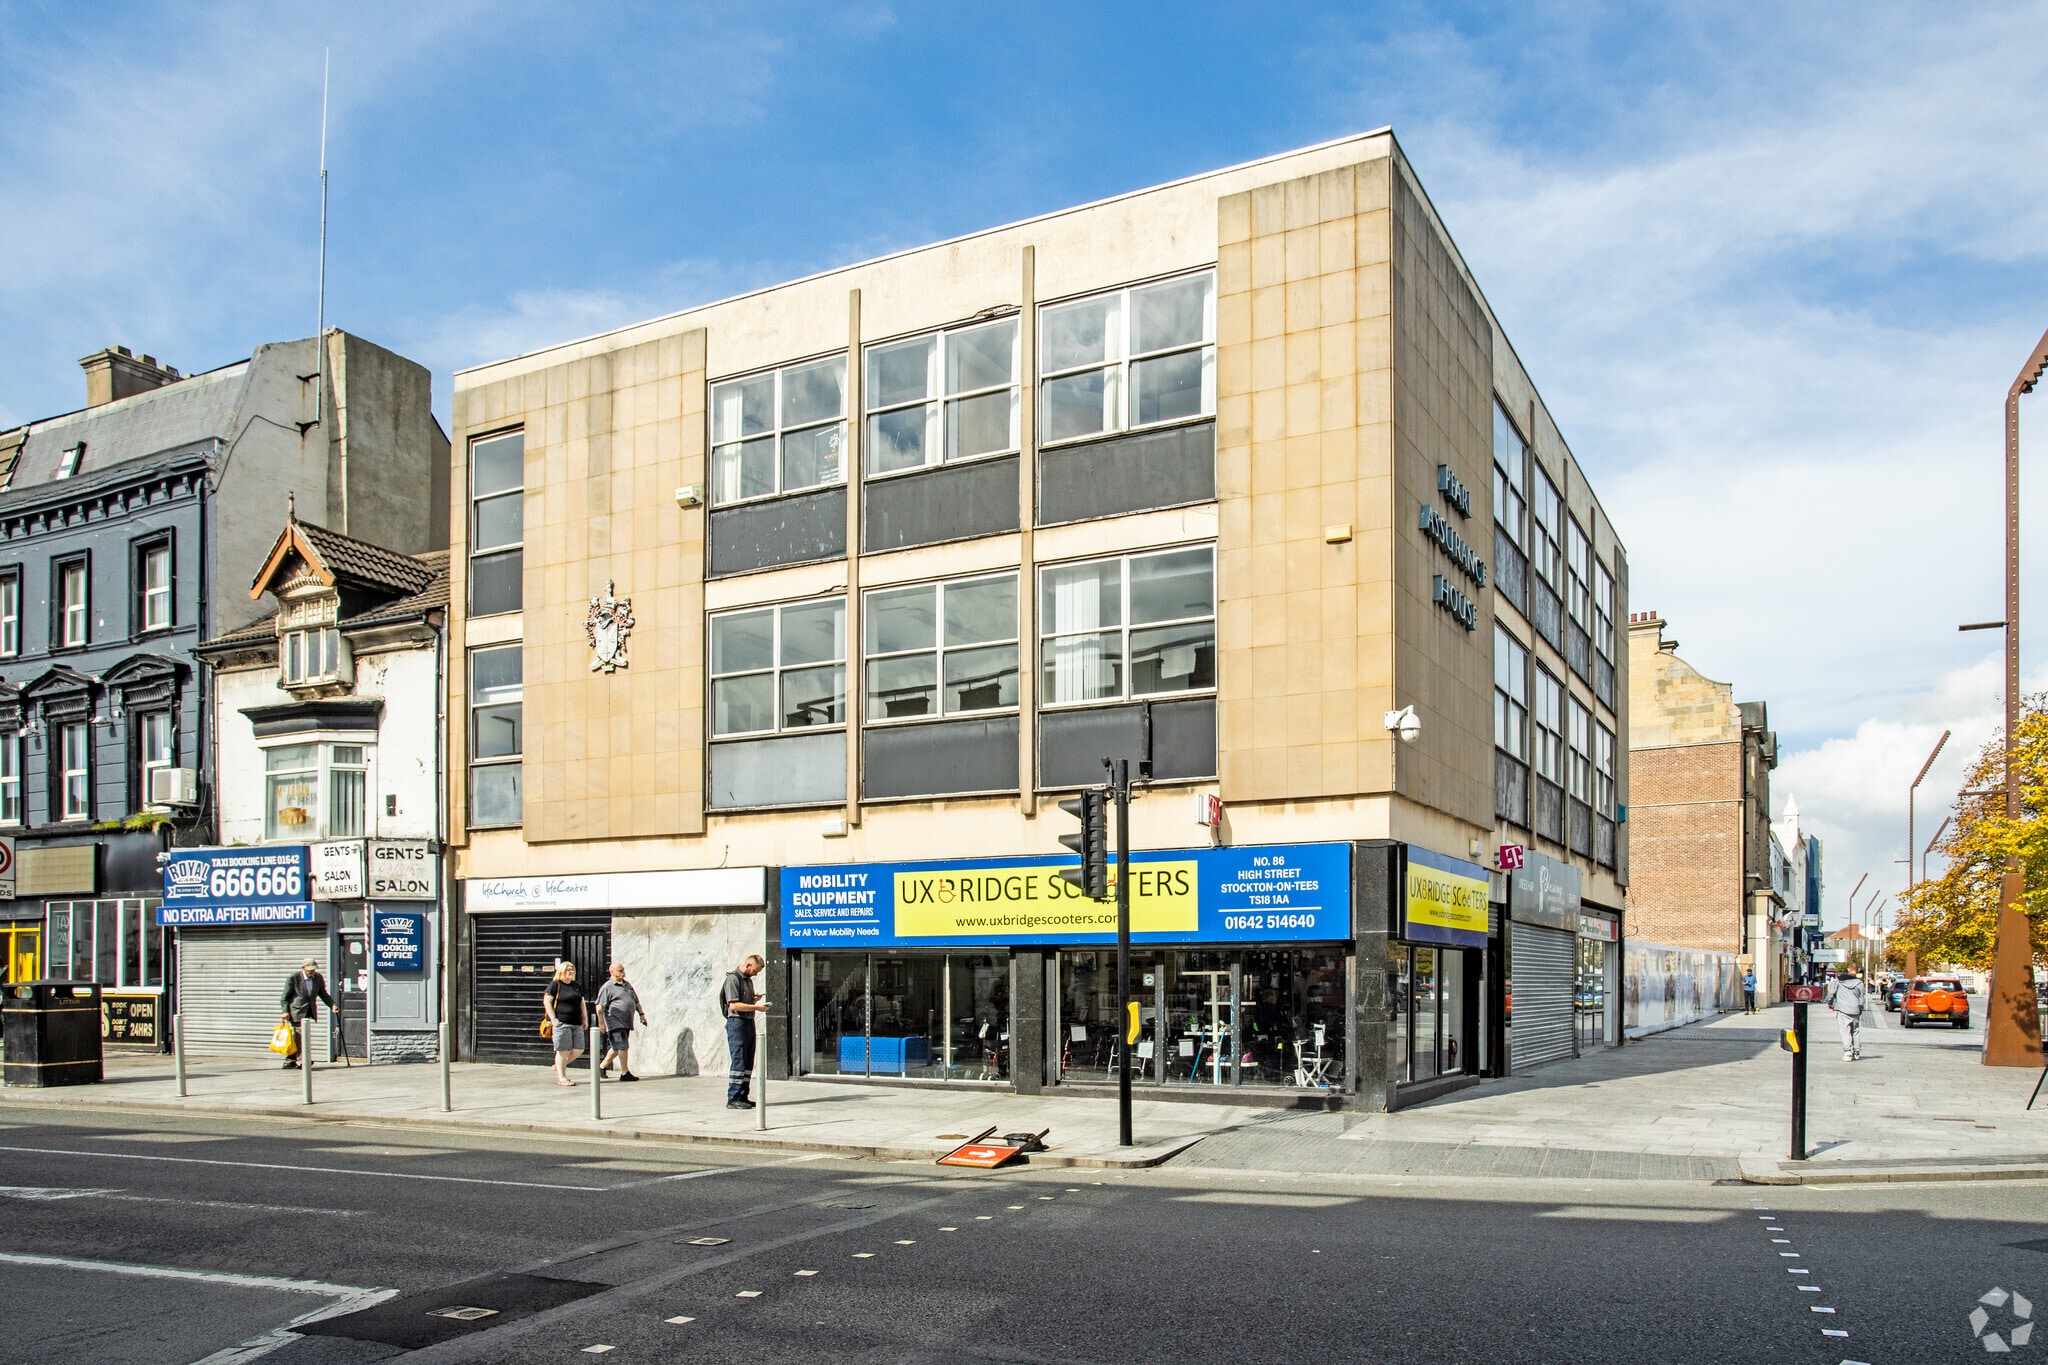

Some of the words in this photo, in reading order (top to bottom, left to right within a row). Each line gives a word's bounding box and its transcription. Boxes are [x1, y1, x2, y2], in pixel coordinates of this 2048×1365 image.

[1438, 464, 1472, 520] PEARL
[1419, 504, 1487, 588] ASSURANCE
[1433, 575, 1477, 631] HOUSE
[324, 846, 350, 857] GENTS
[375, 848, 424, 860] GENTS
[211, 859, 228, 867] TAXI
[230, 857, 260, 866] BOOKING
[261, 856, 277, 865] LINE
[277, 855, 299, 864] 01642
[1253, 857, 1271, 867] NO.
[1272, 856, 1285, 866] 86
[168, 861, 209, 880] ROYAL
[324, 870, 351, 881] SALON
[1238, 870, 1263, 880] HIGH
[1264, 868, 1301, 879] STREET
[375, 880, 429, 892] SALON
[800, 873, 868, 889] MOBILITY
[1221, 881, 1319, 893] STOCKTON-ON-TEES
[902, 876, 1038, 904] UXBRIDGE
[1410, 876, 1450, 904] UXBRIDGE
[793, 890, 876, 907] EQUIPMENT
[1249, 895, 1271, 905] TS18
[1272, 895, 1290, 904] 1AA
[163, 909, 179, 922] NO
[181, 908, 213, 922] EXTRA
[215, 907, 249, 922] AFTER
[251, 906, 307, 921] MIDNIGHT
[794, 909, 813, 918] SALES,
[813, 908, 836, 917] SERVICE
[837, 908, 849, 917] AND
[850, 907, 873, 916] REPAIRS
[354, 916, 359, 924] 4
[380, 917, 414, 928] ROYAL
[1225, 916, 1264, 929] 01642
[1266, 914, 1315, 928] 514640
[802, 928, 811, 936] All
[812, 928, 828, 936] Your
[829, 928, 855, 937] Mobility
[857, 928, 879, 936] Needs
[377, 944, 418, 952] BOOKING
[130, 1003, 153, 1017] OPEN
[130, 1023, 153, 1037] 24HRS
